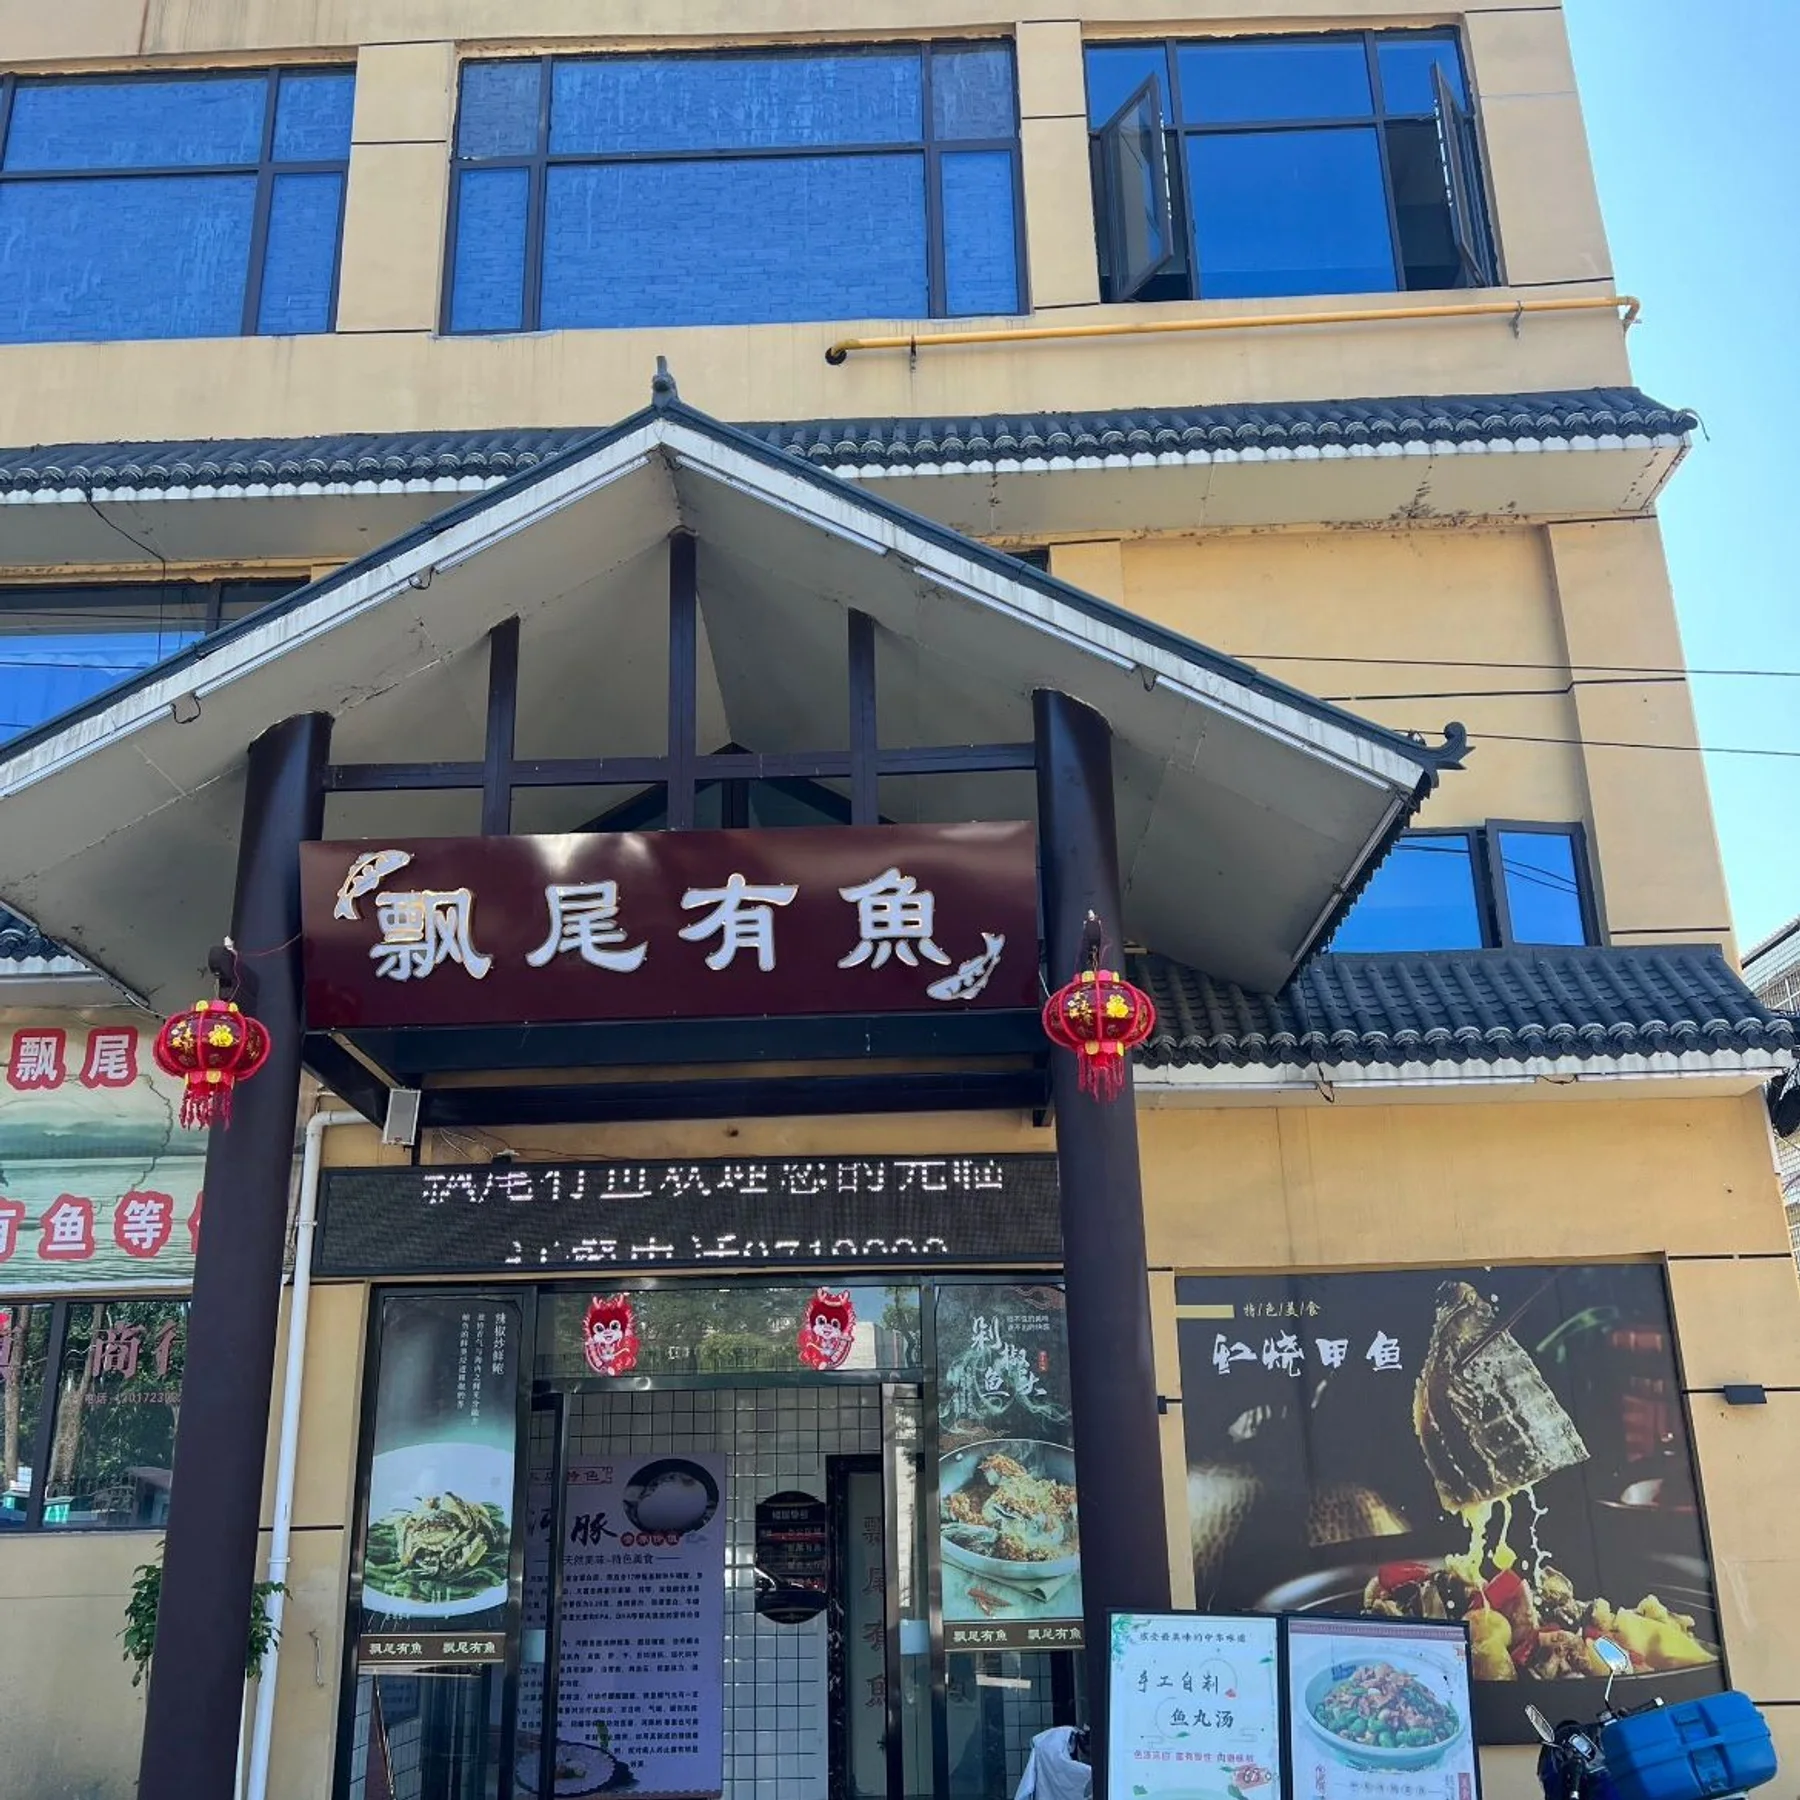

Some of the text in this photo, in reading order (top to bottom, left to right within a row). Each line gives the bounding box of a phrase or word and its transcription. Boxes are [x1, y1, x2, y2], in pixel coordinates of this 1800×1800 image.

[16, 1034, 131, 1083] 飘尾
[0, 1199, 200, 1251] 鱼等
[1213, 1330, 1402, 1376] 红烧甲鱼
[1137, 1671, 1220, 1694] 手工自制
[1169, 1707, 1235, 1728] 鱼丸汤
